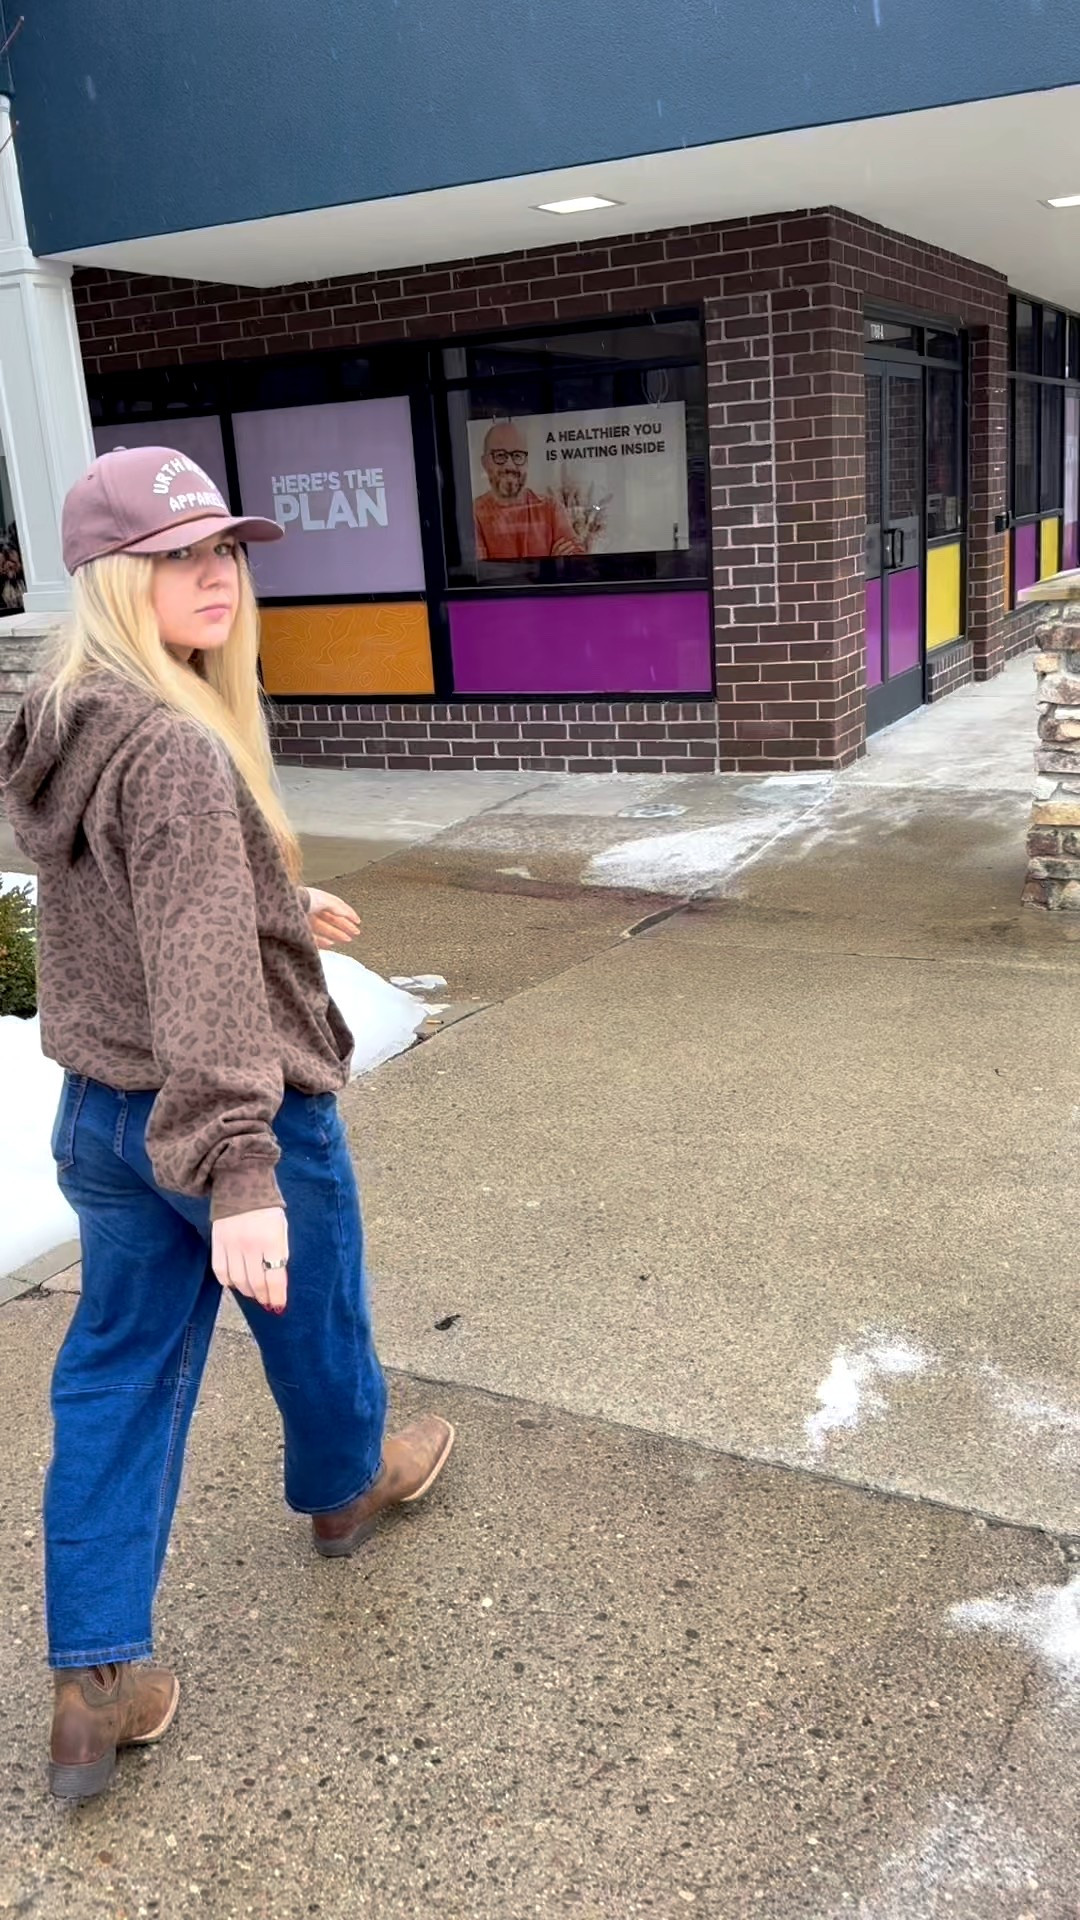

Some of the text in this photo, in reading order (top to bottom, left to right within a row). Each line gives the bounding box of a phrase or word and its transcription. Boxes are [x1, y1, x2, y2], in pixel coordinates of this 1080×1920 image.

[546, 423, 662, 443] A HEALTHIER YOU
[546, 441, 666, 461] IS WAITING INSIDE
[271, 467, 385, 494] HERE'S THE
[273, 487, 389, 531] PLAN
